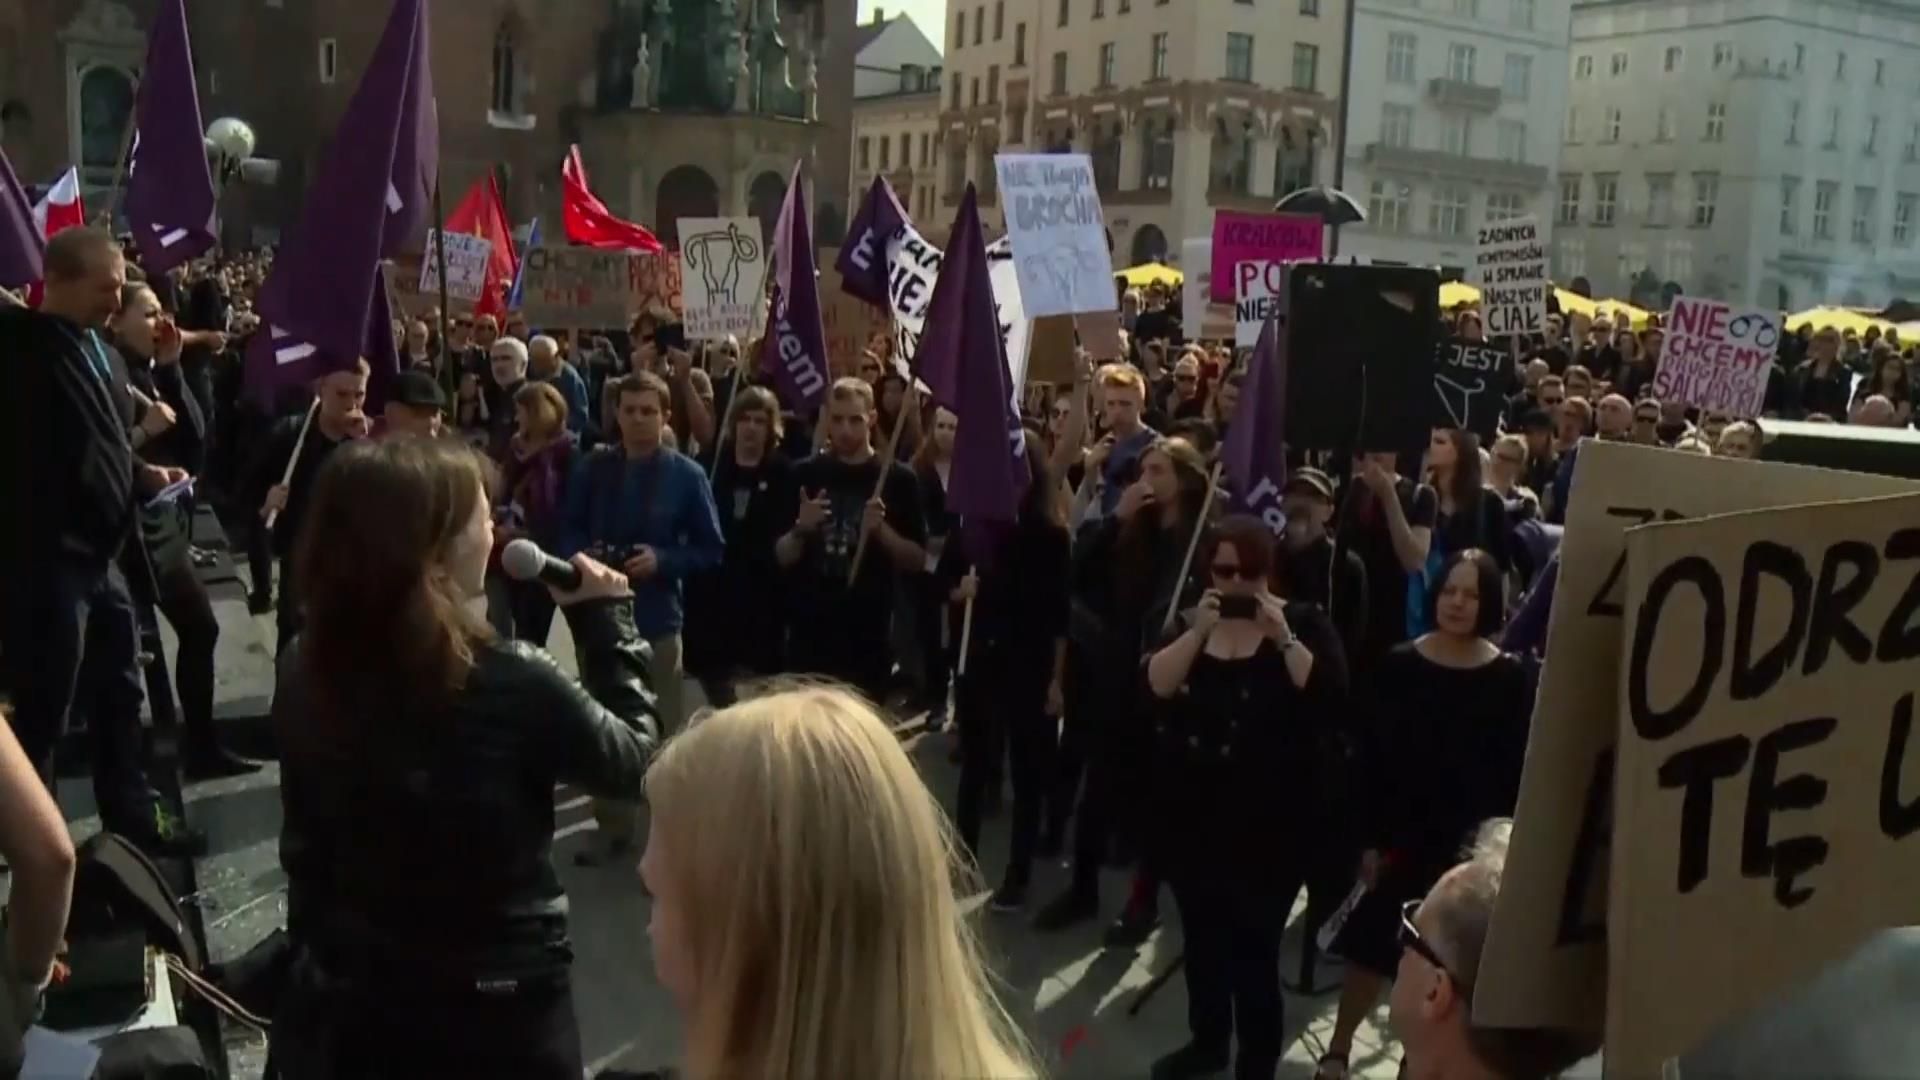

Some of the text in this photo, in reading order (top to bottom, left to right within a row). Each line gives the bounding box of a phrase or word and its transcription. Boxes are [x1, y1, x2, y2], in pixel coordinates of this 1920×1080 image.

[1488, 306, 1540, 331] CIAŁ
[1671, 301, 1729, 341] NIE
[1447, 344, 1508, 371] JEST
[1669, 335, 1771, 373] CHCEMY
[1629, 527, 1920, 740] ODRZ
[1658, 717, 1837, 908] TĘ
